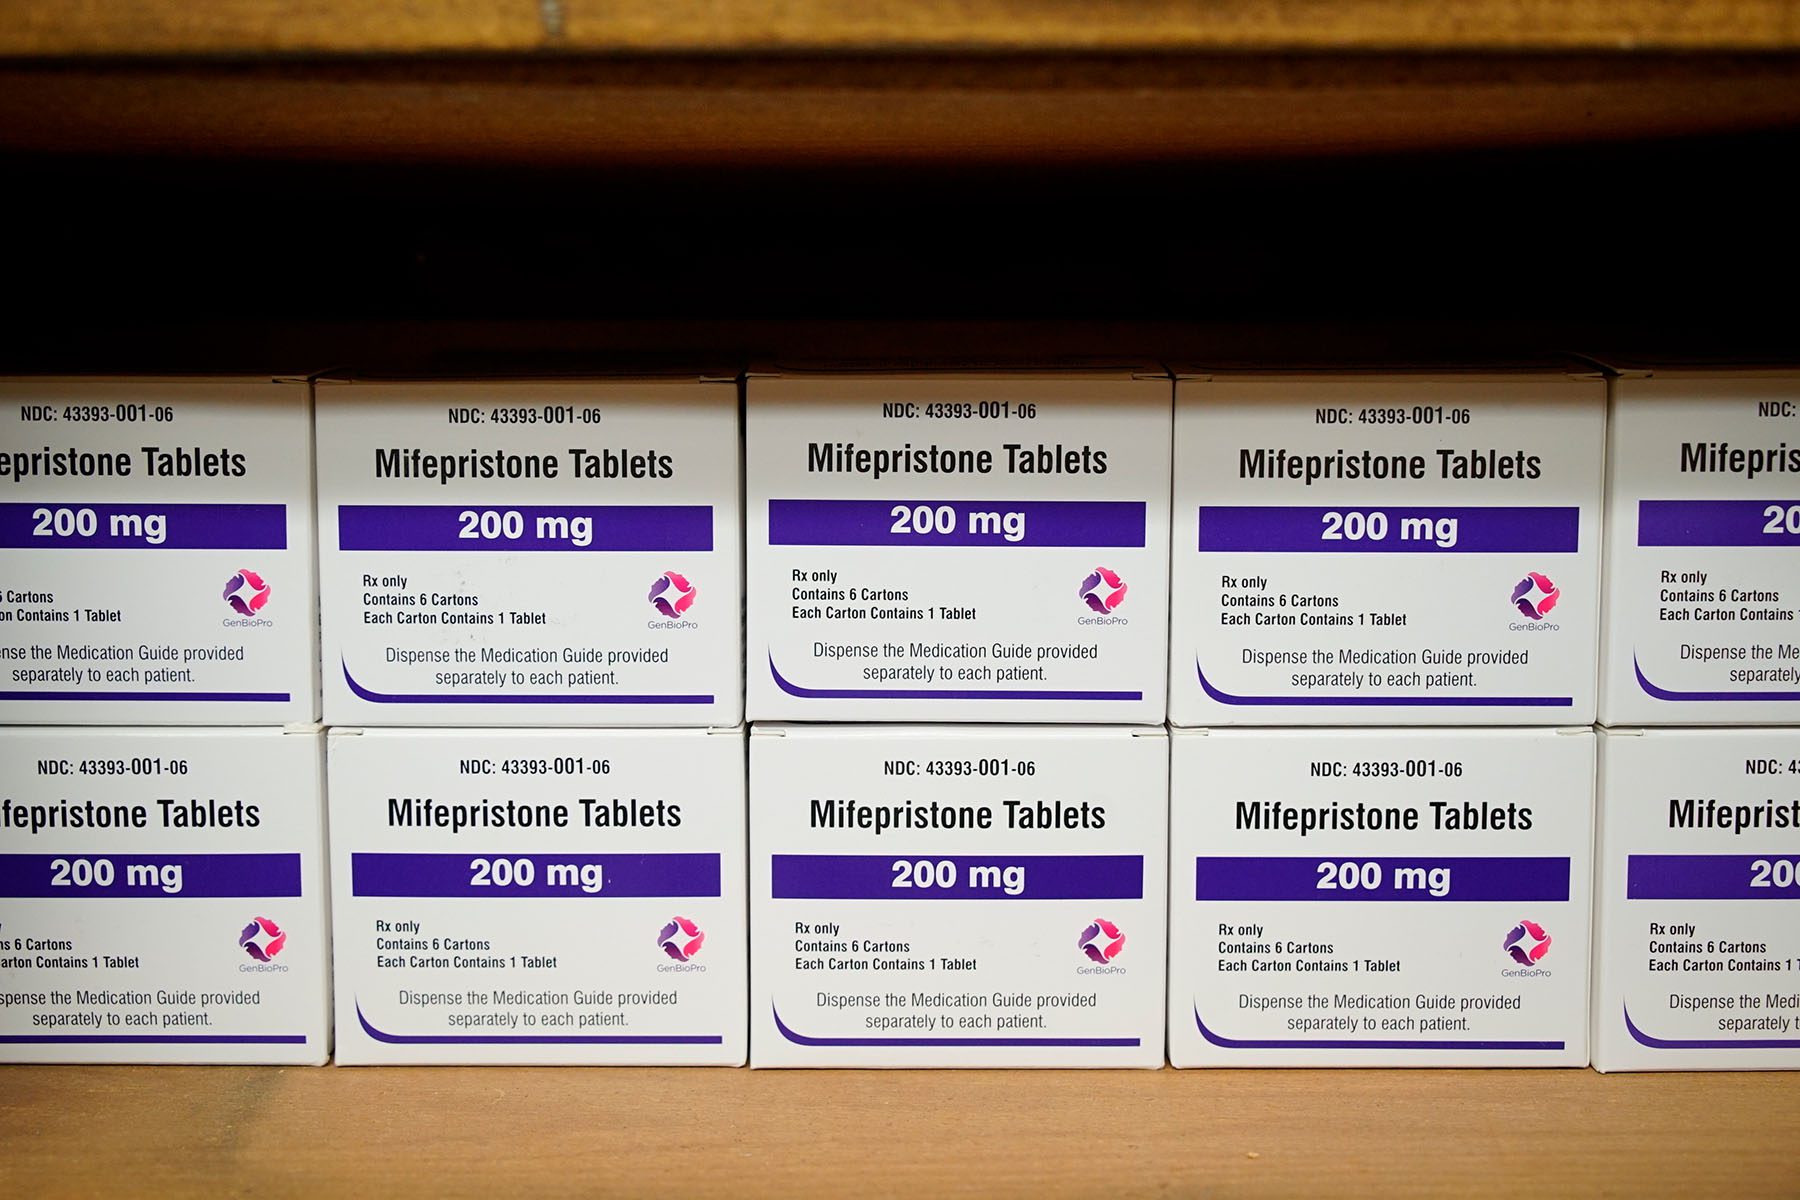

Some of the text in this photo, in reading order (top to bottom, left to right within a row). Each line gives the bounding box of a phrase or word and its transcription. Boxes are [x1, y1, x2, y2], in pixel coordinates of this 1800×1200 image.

[21, 404, 173, 422] NDC: 43393-001-06
[449, 406, 600, 423] NDC: 43393-001-06
[884, 401, 1036, 418] NDC: 43393-001-06
[1316, 406, 1470, 424] NDC: 43393-001-06
[1759, 402, 1796, 417] NDC:
[376, 449, 672, 484] Mifepristone Tablets
[809, 443, 1107, 479] Mifepristone Tablets
[1240, 449, 1540, 485] Mifepristone Tablets
[33, 508, 166, 544] 200 mg
[459, 511, 592, 546] 200 mg
[891, 506, 1024, 541] 200 mg
[1322, 512, 1457, 547] 200 mg
[793, 569, 837, 584] Rx only
[1662, 571, 1707, 586] Rx only
[364, 593, 478, 606] Contains 6 Cartons
[792, 588, 908, 600] Contains 6 Cartons
[1661, 589, 1778, 602] Contains 6 Cartons
[223, 619, 272, 627] GenBioPro
[364, 612, 546, 624] Each Carton Contains 1 Tablet
[648, 621, 698, 629] GenBioPro
[1222, 613, 1406, 625] Each Carton Contains 1 Tablet
[387, 648, 668, 666] Dispense the Medication Guide provided
[814, 642, 1097, 661] Dispense the Medication Guide provided
[1243, 649, 1528, 667] Dispense the Medication Guide provided
[13, 667, 194, 684] separately to each patient.
[864, 666, 1046, 683] separately to each patient.
[1292, 672, 1476, 689] separately to each patient.
[38, 758, 187, 775] NDC: 43393-001-06
[460, 758, 610, 774] NDC: 43393-001-06
[885, 759, 1035, 776] NDC: 43393-001-06
[1311, 760, 1462, 776] NDC: 43393-001-06
[1746, 760, 1782, 774] NDC:
[389, 799, 680, 833] Mifepristone Tablets
[811, 800, 1105, 834] Mifepristone Tablets
[1236, 802, 1532, 836] Mifepristone Tablets
[51, 859, 182, 893] 200 mg
[470, 859, 602, 893] 200 mg
[892, 860, 1024, 895] 200 mg
[1317, 862, 1450, 896] 200 mg
[377, 920, 419, 934] Rx only
[1650, 923, 1695, 937] Rx only
[377, 938, 490, 950] Contains 6 Cartons
[796, 940, 909, 952] Contains 6 Cartons
[1650, 941, 1766, 953] Contains 6 Cartons
[239, 964, 288, 972] GenBioPro
[796, 958, 976, 970] Each Carton Contains 1 Tablet
[1077, 966, 1126, 974] GenBioPro
[1219, 960, 1400, 972] Each Carton Contains 1 Tablet
[400, 990, 676, 1007] Dispense the Medication Guide provided
[817, 992, 1096, 1010] Dispense the Medication Guide provided
[1240, 994, 1520, 1012] Dispense the Medication Guide provided
[33, 1012, 212, 1028] separately to each patient.
[449, 1012, 628, 1028] separately to each patient.
[1288, 1016, 1470, 1033] separately to each patient.
